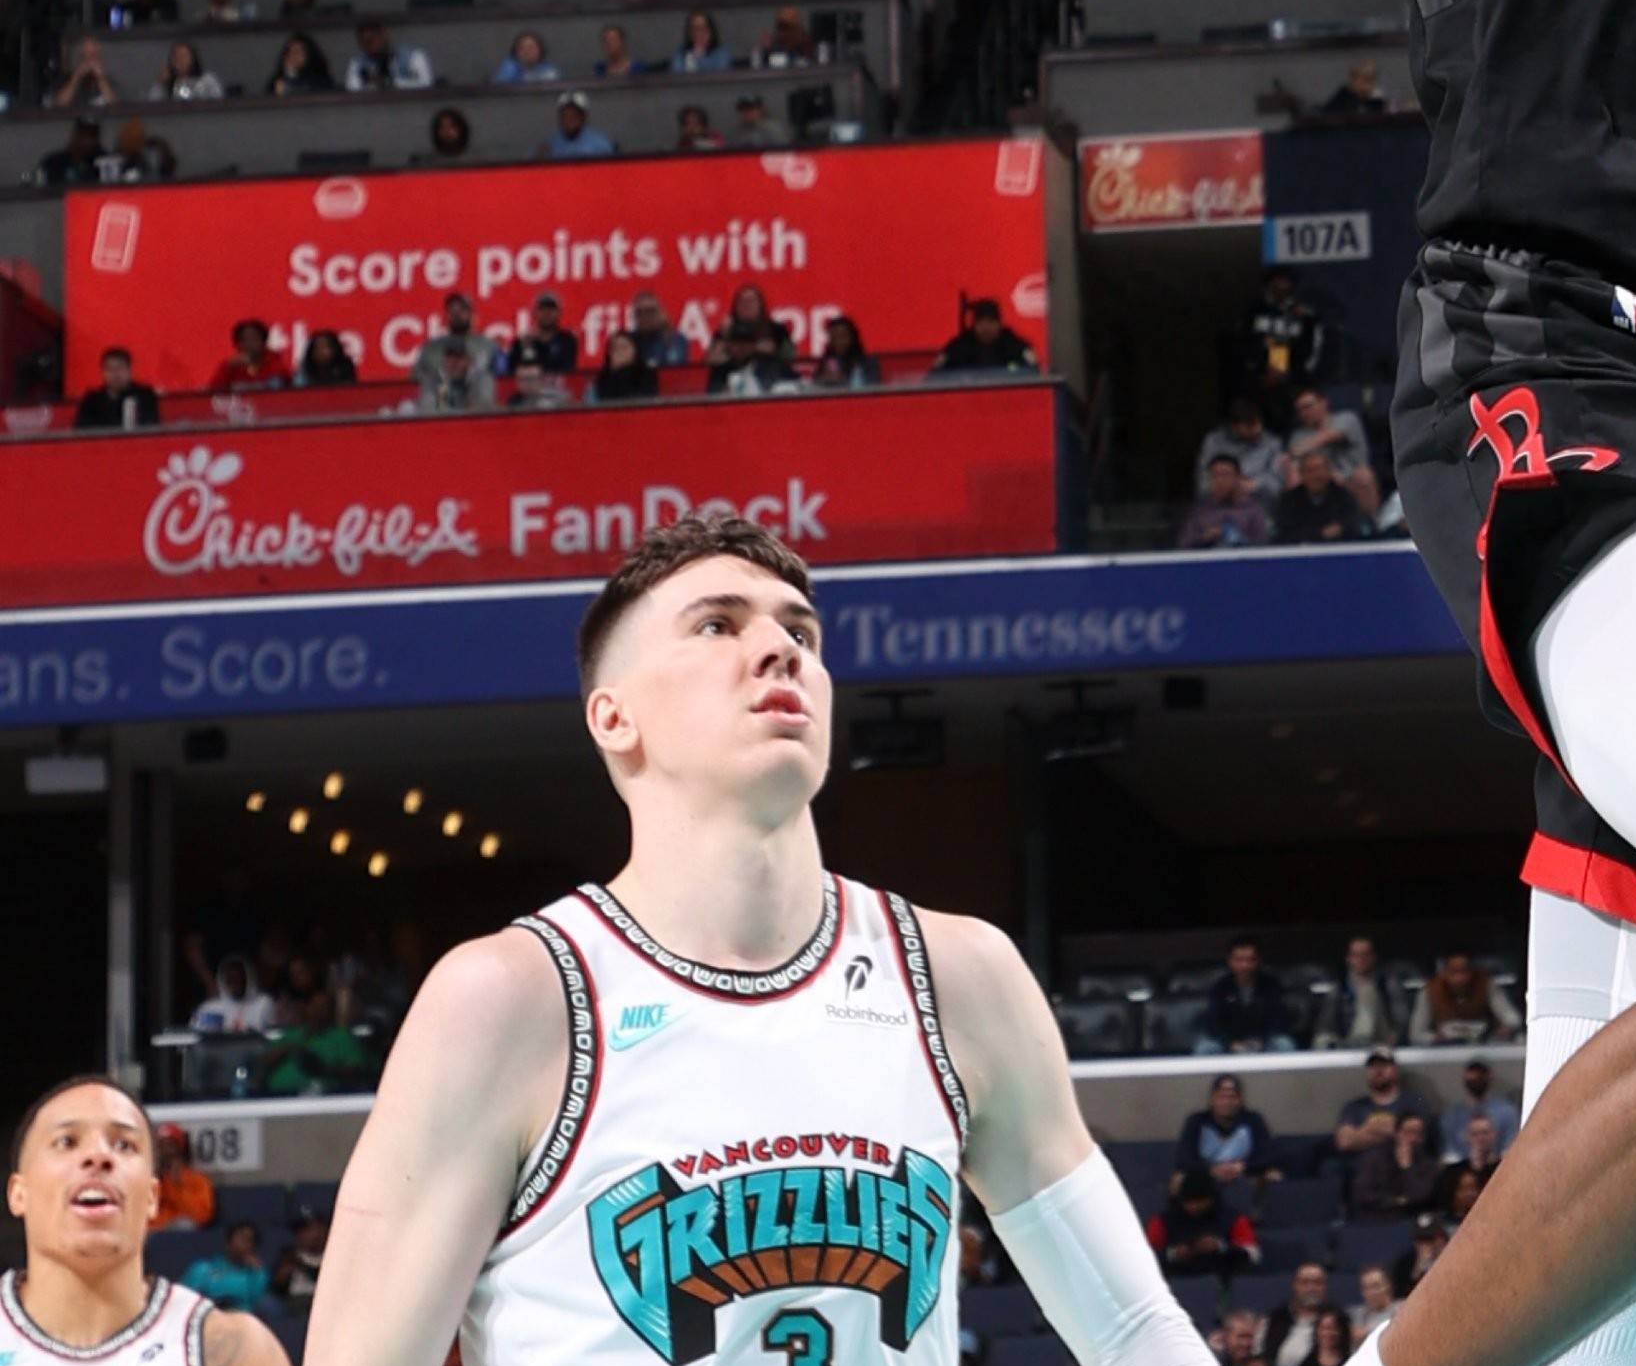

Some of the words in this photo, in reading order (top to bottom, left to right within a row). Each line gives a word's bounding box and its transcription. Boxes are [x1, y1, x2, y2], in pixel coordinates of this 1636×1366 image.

[287, 241, 461, 297] Score
[476, 228, 662, 299] points
[676, 218, 808, 276] with
[1286, 221, 1360, 256] 107A
[143, 447, 480, 576] Chick-fil-A
[836, 604, 1186, 666] Tennessee
[160, 628, 389, 699] Score.
[619, 1003, 671, 1030] NIKE
[825, 1003, 908, 1026] Robinhood
[190, 1126, 241, 1164] 08
[672, 1133, 894, 1179] VANCOUVER
